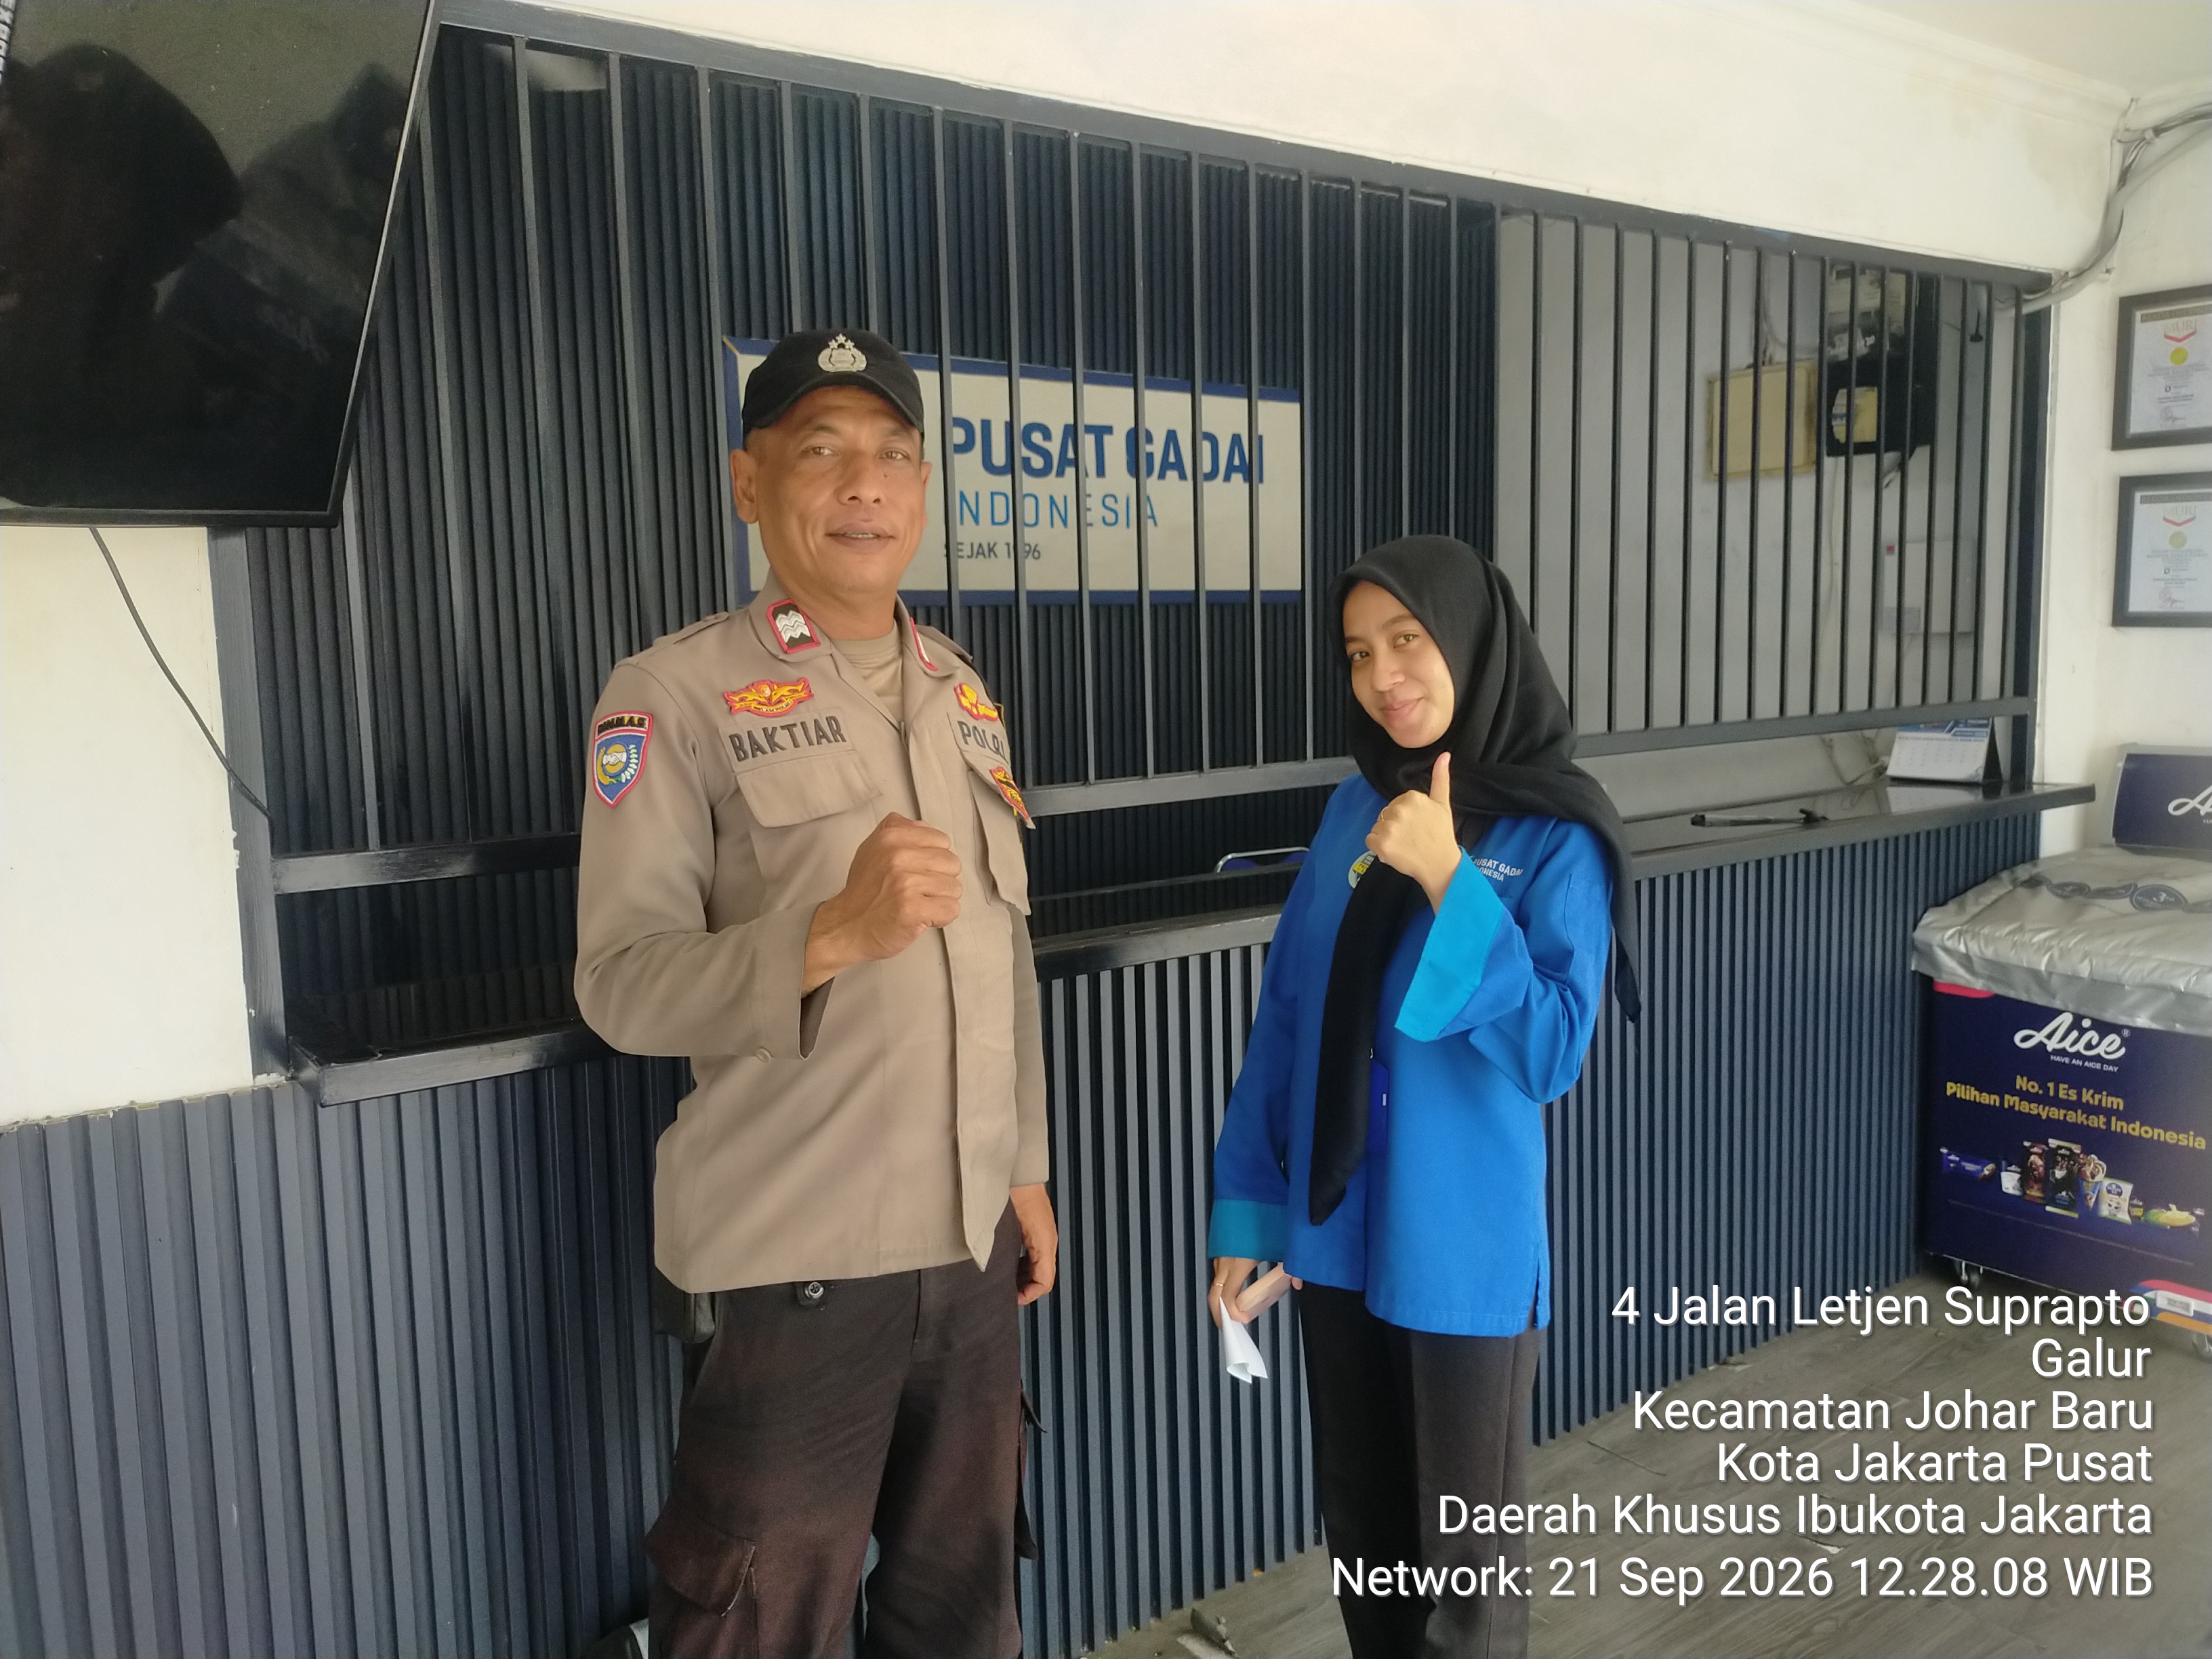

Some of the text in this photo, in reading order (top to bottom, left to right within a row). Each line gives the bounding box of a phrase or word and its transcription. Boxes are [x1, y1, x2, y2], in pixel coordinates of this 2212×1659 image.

[951, 417, 1265, 485] PUSAT GADAI
[956, 489, 1159, 530] NDONESIA
[944, 541, 1042, 560] EJAK 196
[729, 716, 848, 763] BAKTIAR
[1478, 866, 1504, 882] ONESIA
[2013, 1012, 2126, 1060] Aice
[2050, 1054, 2118, 1073] HAVE AN AICE DAY
[2015, 1075, 2124, 1111] No. 1 Es Krim
[1946, 1081, 2207, 1151] Pilihan Masyarakat Indonesia
